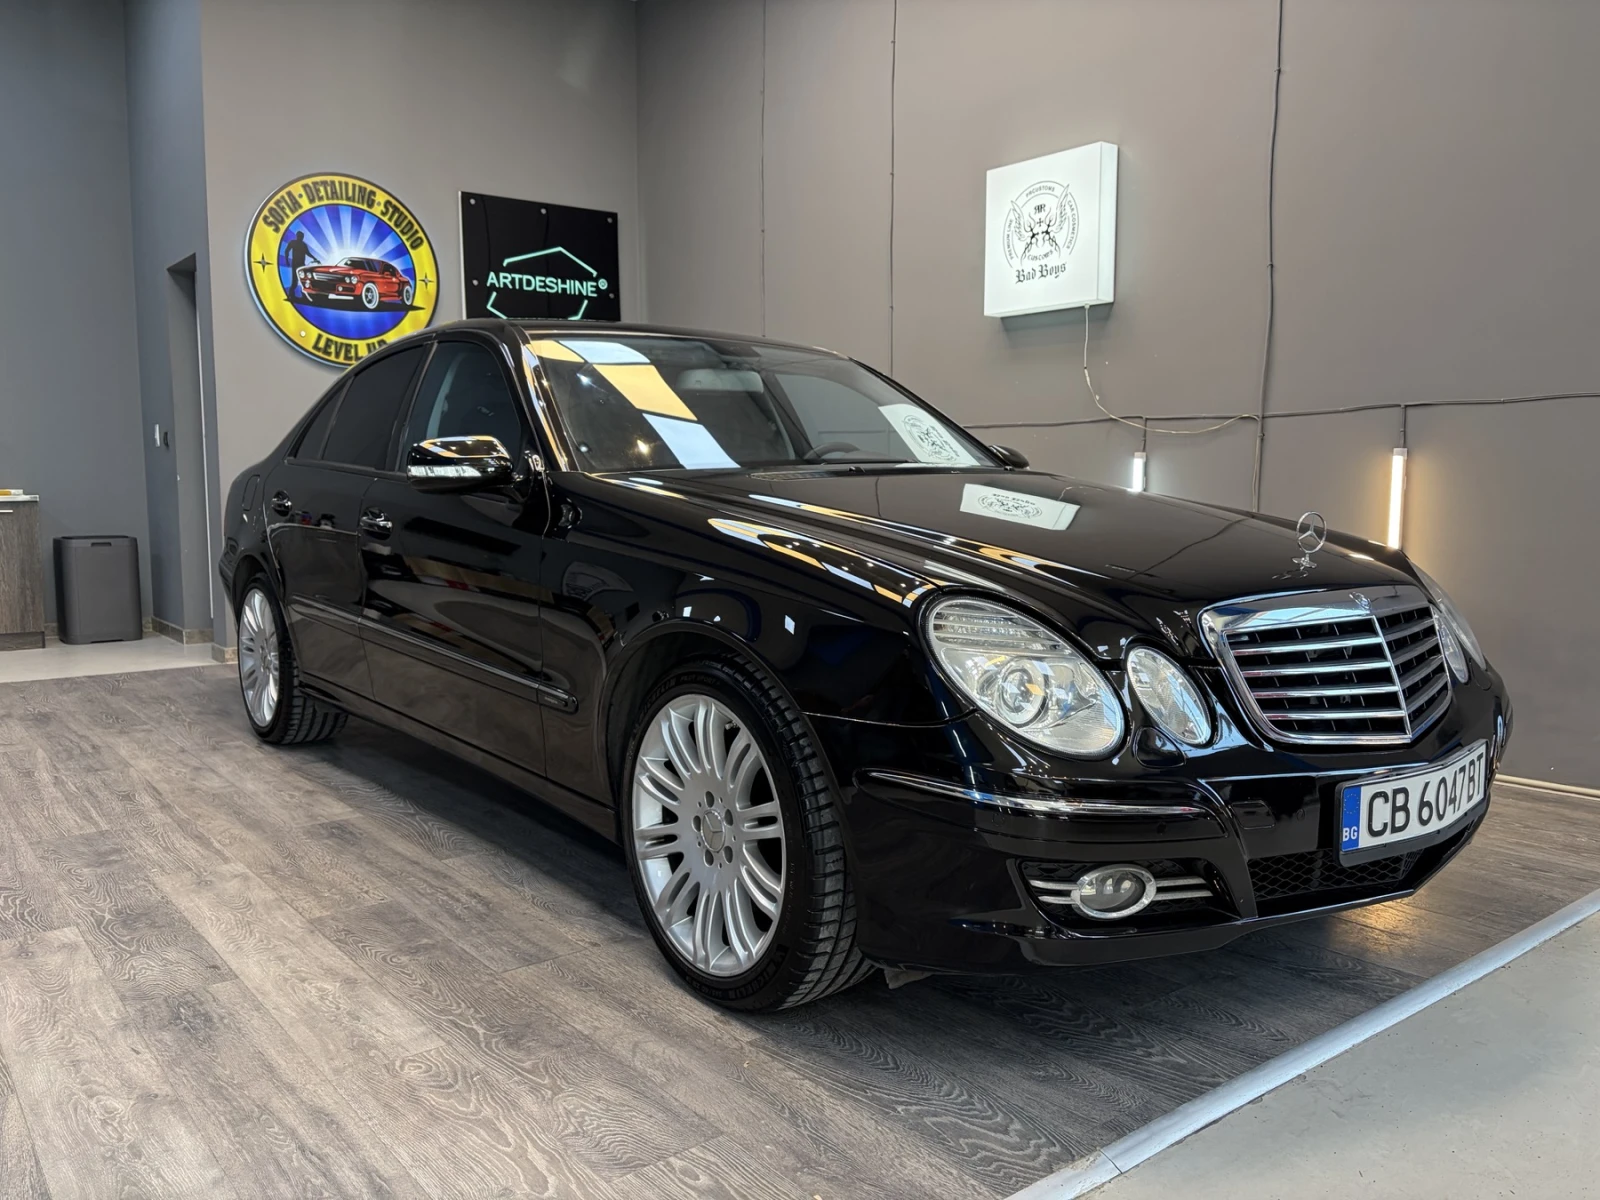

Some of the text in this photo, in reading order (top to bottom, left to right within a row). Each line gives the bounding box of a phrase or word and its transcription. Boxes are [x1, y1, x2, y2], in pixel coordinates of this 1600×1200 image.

[262, 180, 425, 251] SOFIA DETAILING STUDIO
[1015, 262, 1067, 284] Bad Boys
[312, 333, 361, 362] LEVEL
[1367, 786, 1411, 837] CB
[1342, 826, 1358, 842] BG
